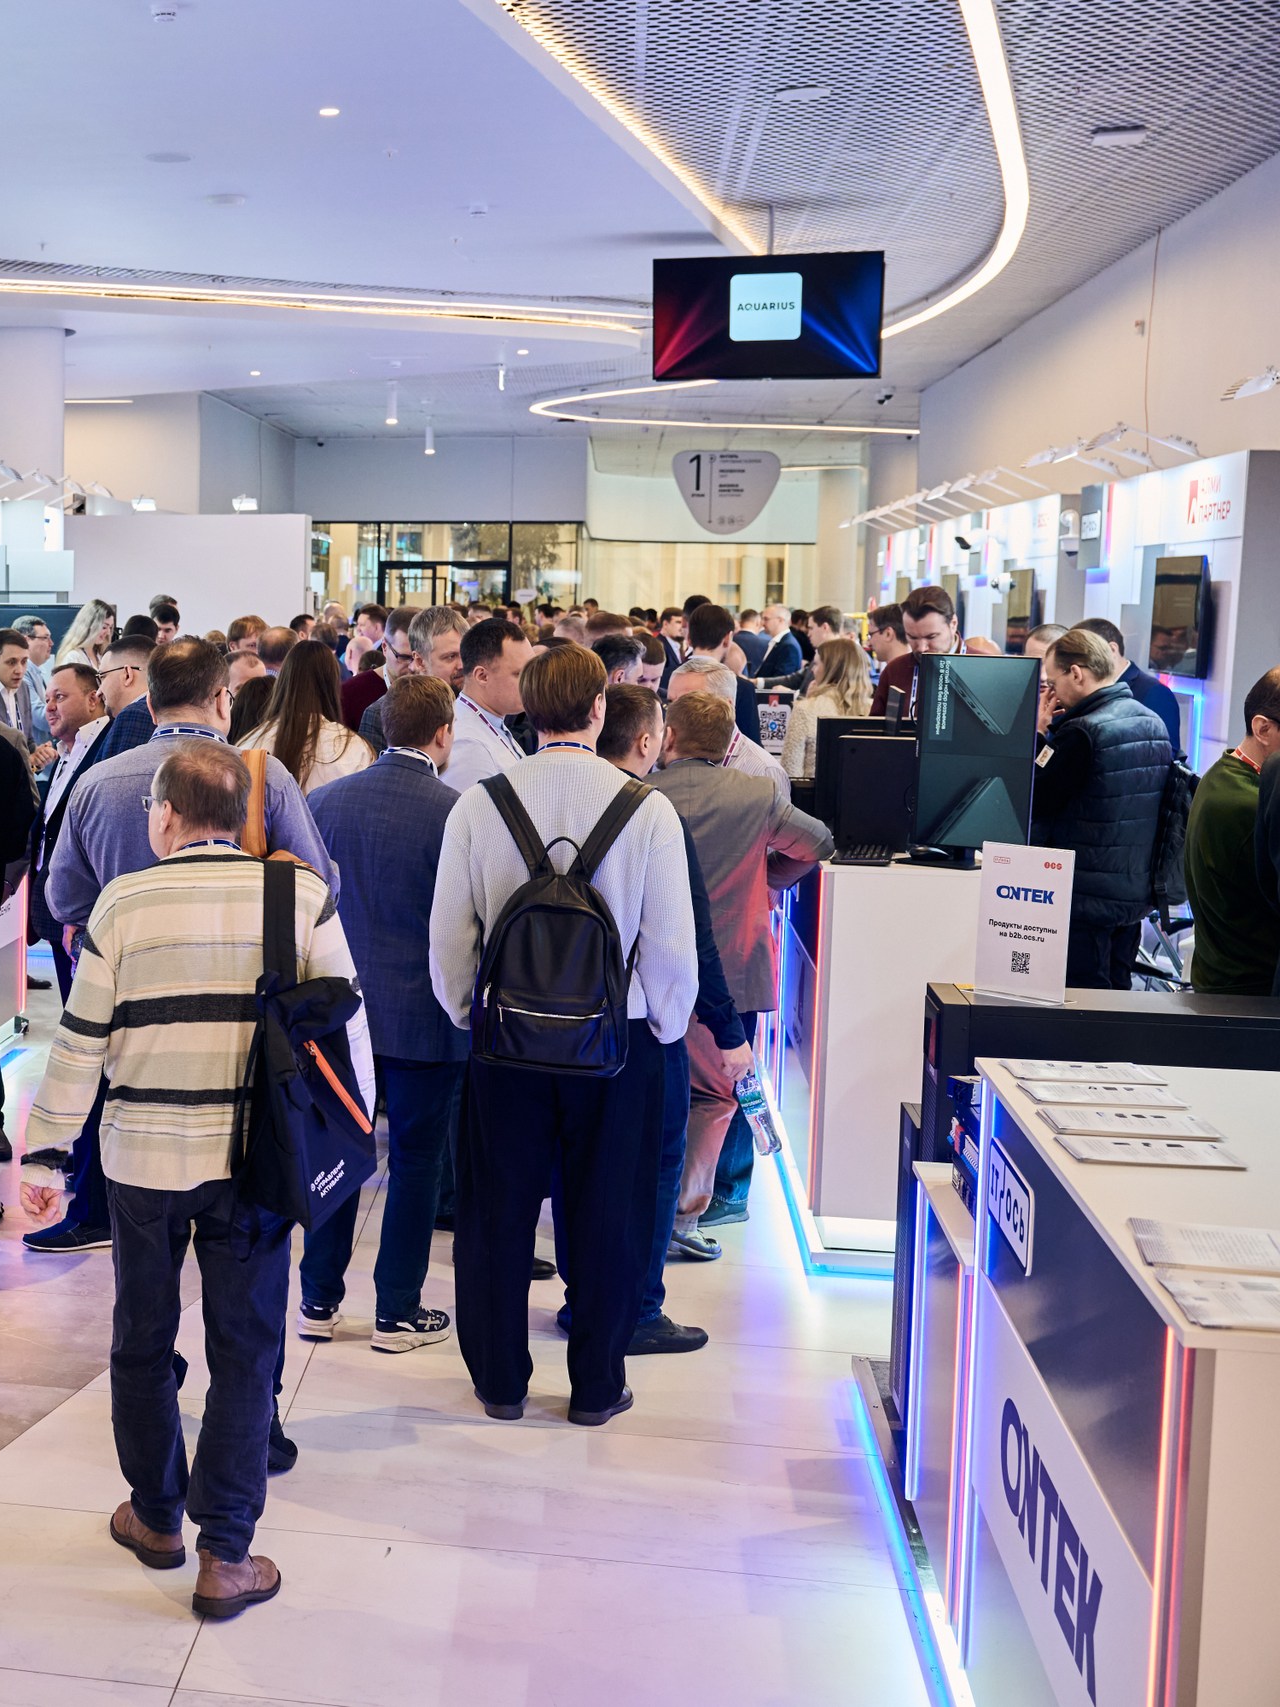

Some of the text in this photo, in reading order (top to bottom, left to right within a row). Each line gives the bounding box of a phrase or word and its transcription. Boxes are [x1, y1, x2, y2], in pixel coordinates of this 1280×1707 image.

[737, 301, 795, 311] AQUARIUS
[689, 454, 701, 491] 1
[996, 885, 1055, 905] ONTEK
[988, 918, 1058, 935] Продукты доступны
[1009, 931, 1045, 942] b2b.ocs.ru
[1000, 1398, 1103, 1707] ONTEK
